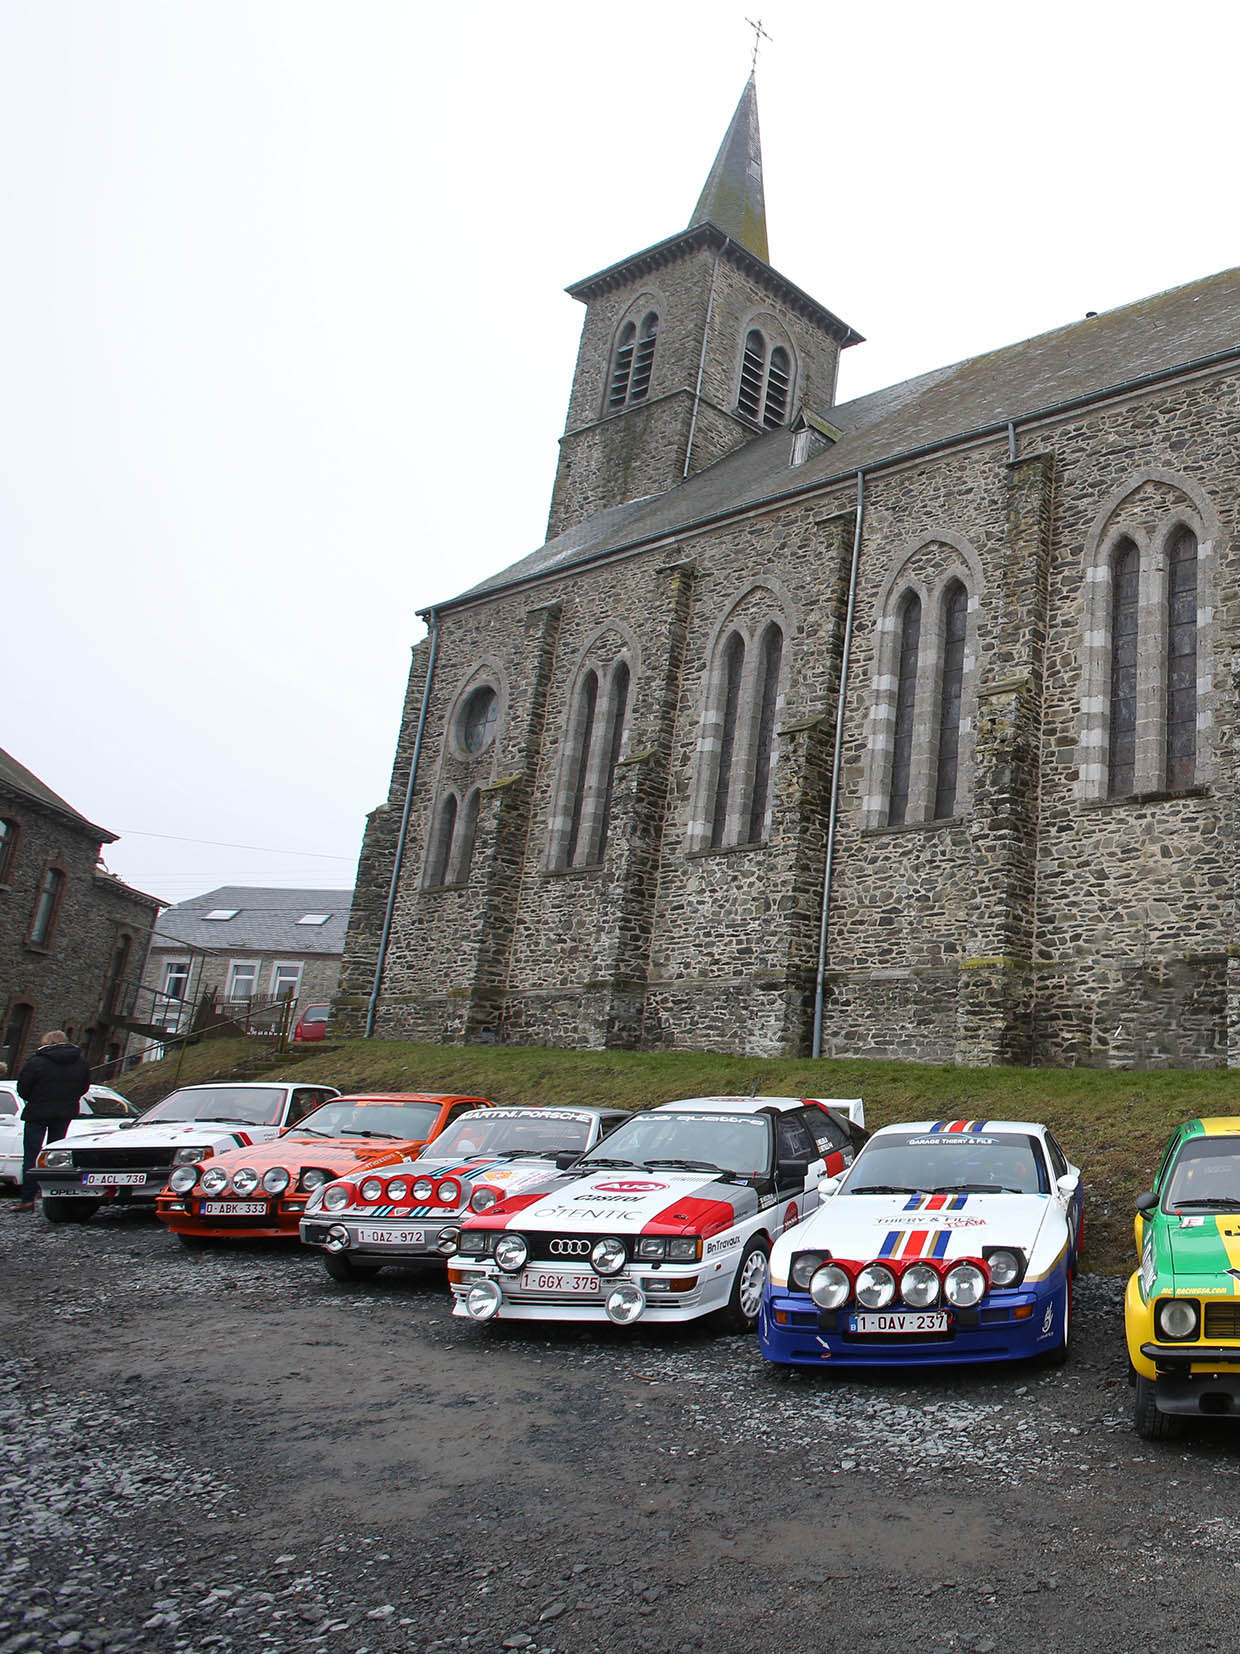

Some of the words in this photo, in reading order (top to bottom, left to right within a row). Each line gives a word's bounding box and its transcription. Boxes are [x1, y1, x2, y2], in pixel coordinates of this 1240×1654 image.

[596, 1182, 664, 1190] Audi
[573, 1194, 647, 1203] Castrol
[360, 1231, 423, 1243] 1-OAZ-972
[523, 1273, 599, 1291] 1-GGX-375
[860, 1315, 945, 1330] 1-OAV-237
